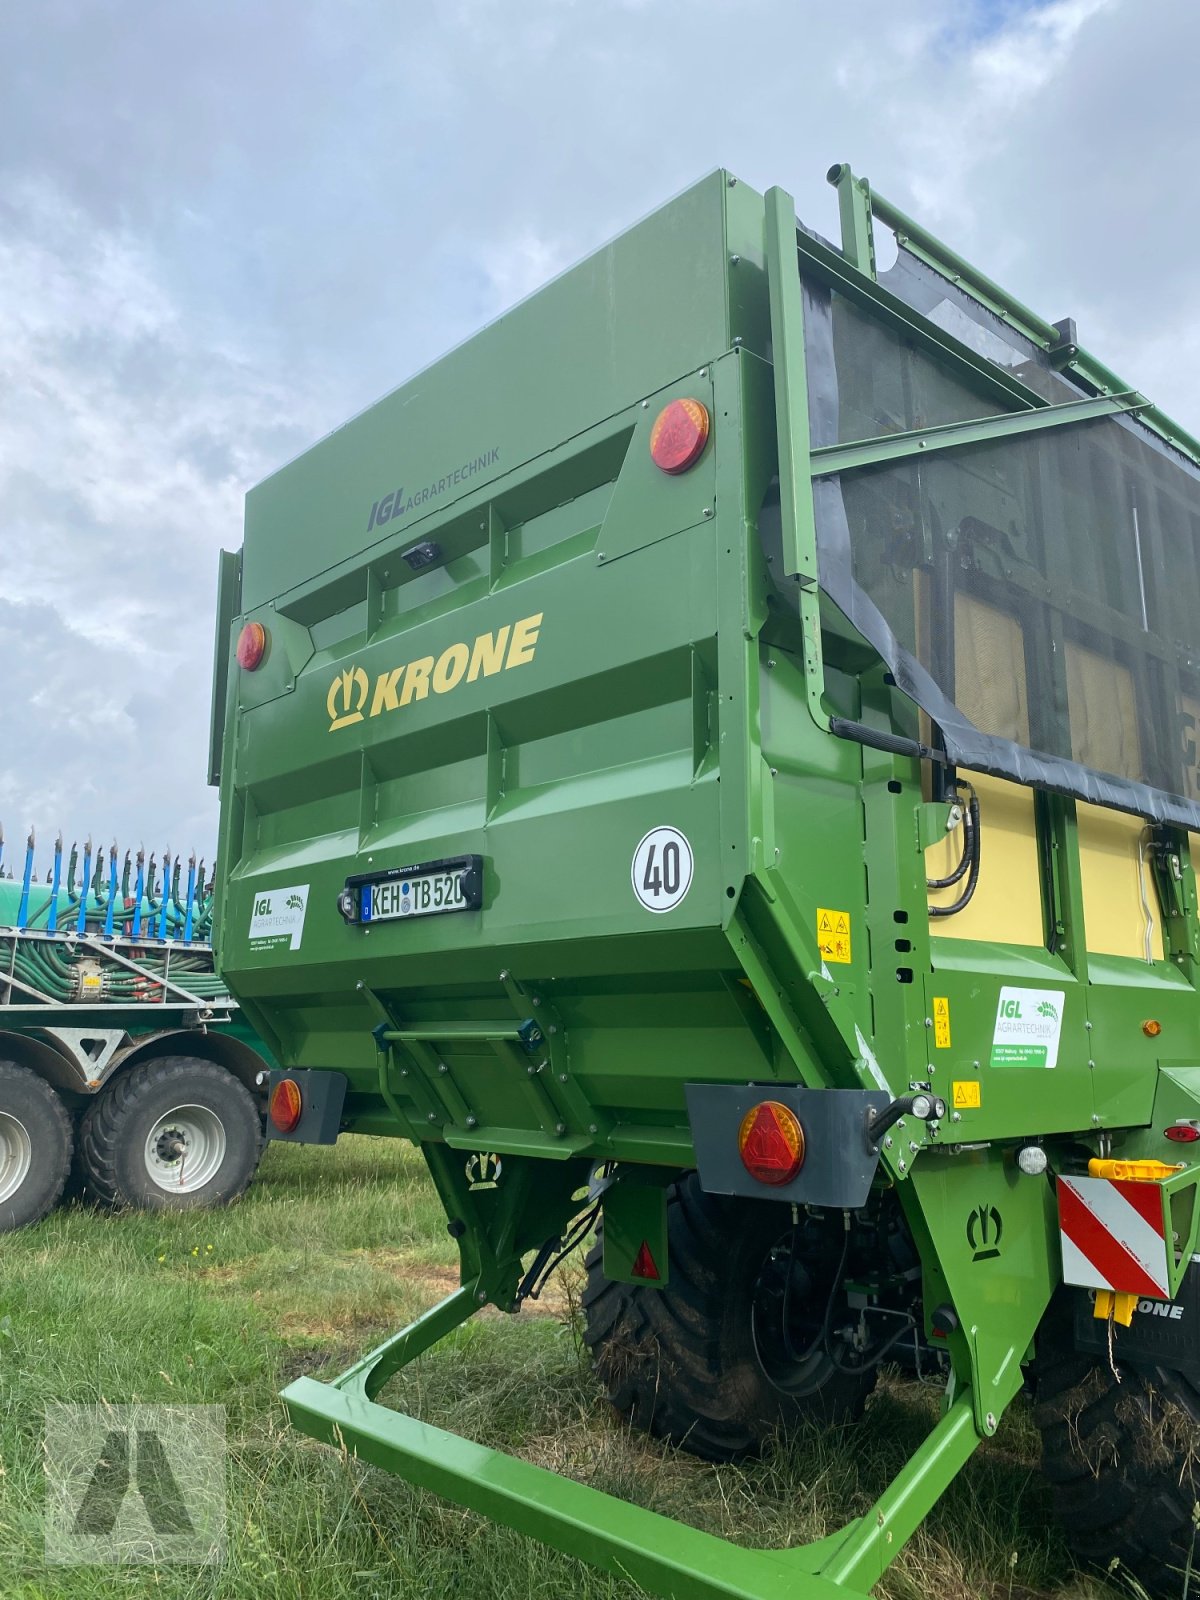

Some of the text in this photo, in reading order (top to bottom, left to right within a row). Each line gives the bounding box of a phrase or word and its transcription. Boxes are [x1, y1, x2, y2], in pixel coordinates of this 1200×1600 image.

[367, 446, 500, 533] IGL AGRARTECHNIK
[369, 612, 544, 718] KRONE
[643, 841, 681, 897] 40
[254, 898, 272, 917] IGL
[372, 884, 400, 916] KEH
[412, 879, 431, 910] TB
[997, 1021, 1051, 1034] AGRARTECHNIK
[999, 999, 1023, 1019] IGL
